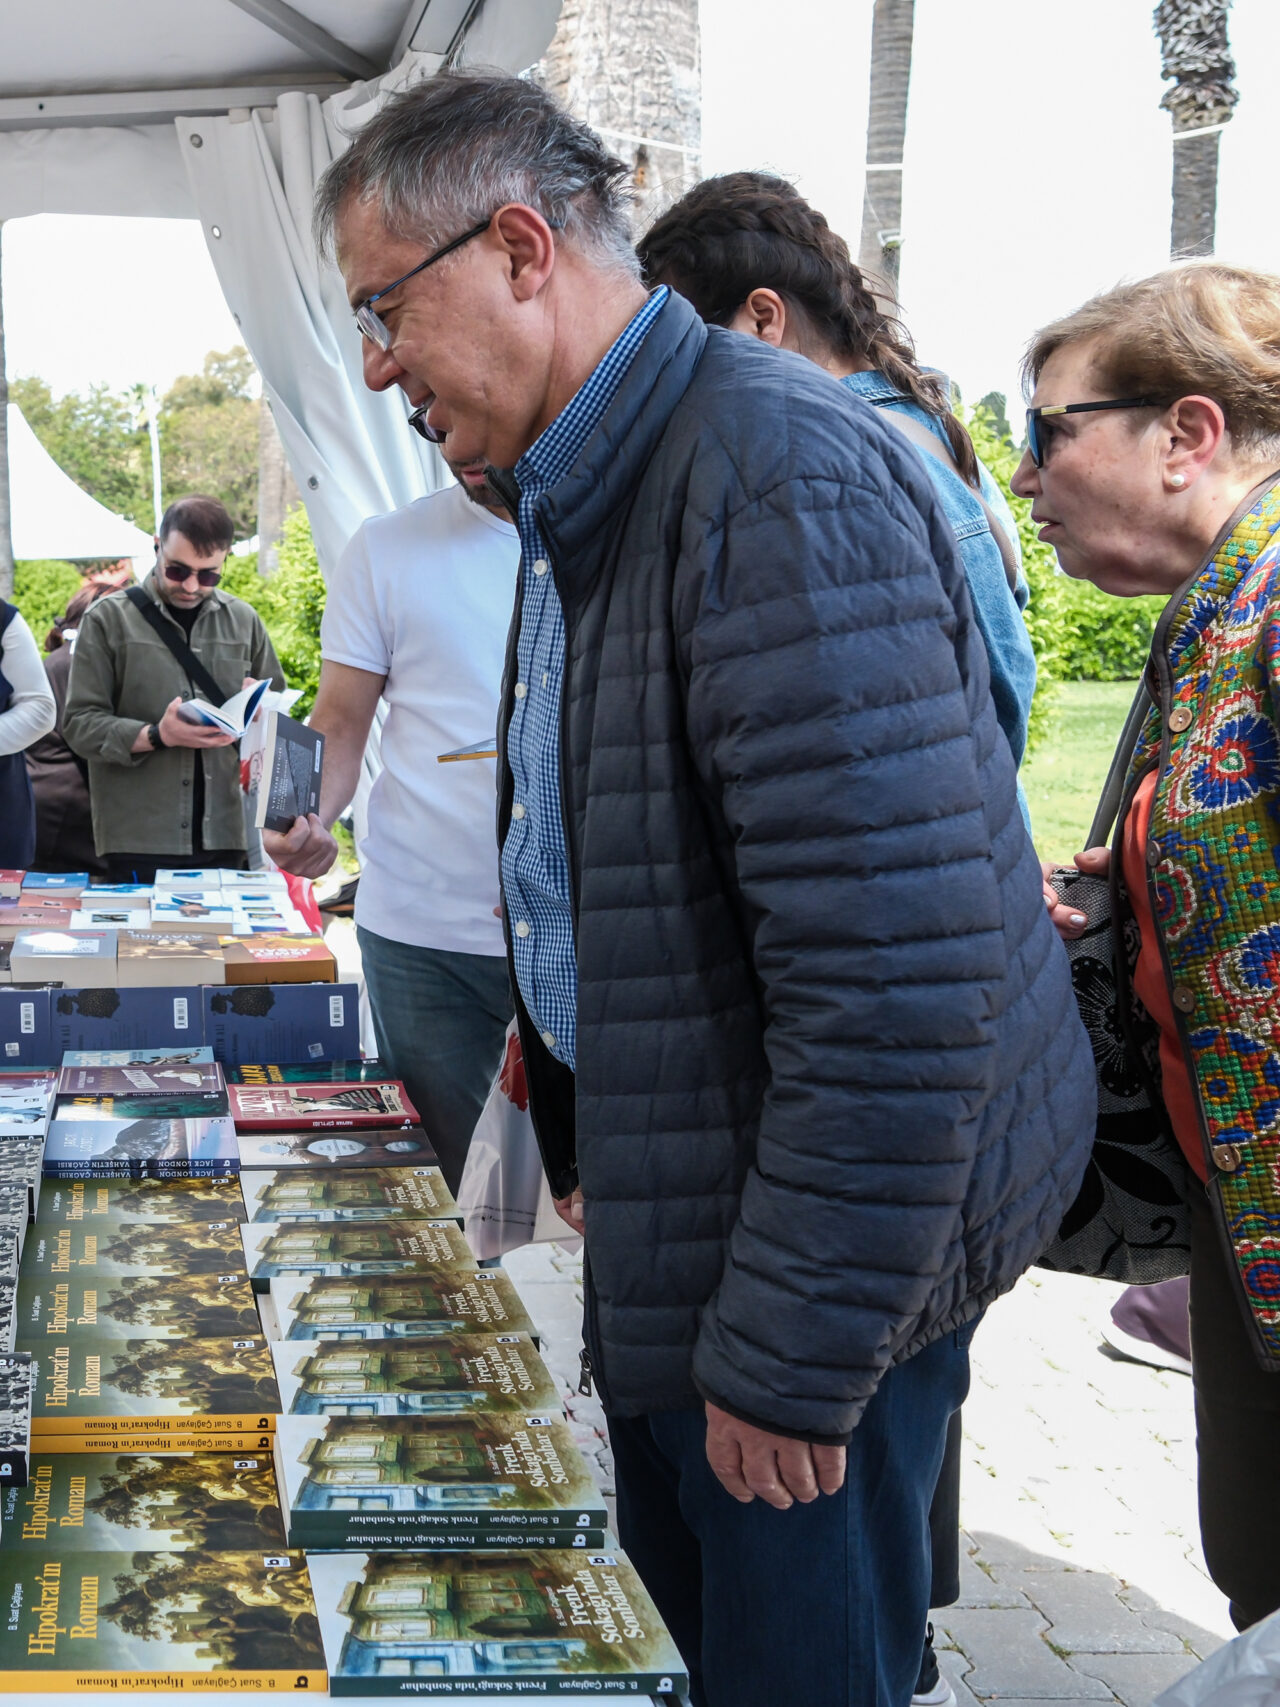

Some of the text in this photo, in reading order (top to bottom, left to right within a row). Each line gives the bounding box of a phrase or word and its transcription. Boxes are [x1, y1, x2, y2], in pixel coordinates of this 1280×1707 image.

[158, 1160, 214, 1168] JACK LONDON
[159, 1170, 215, 1178] JACK LONDON
[47, 1283, 75, 1335] Hipokrat'ın
[77, 1290, 98, 1325] Romanı
[45, 1346, 76, 1407] Hipokrat'ın
[78, 1355, 101, 1397] Romanı
[469, 1356, 494, 1384] Frenk
[505, 1347, 535, 1391] Sonbahar
[84, 1420, 171, 1430] Hipokrat'ın Romanı
[176, 1419, 243, 1429] B. Suat Çağlayan
[85, 1438, 171, 1449] Hipokrat'ın Romanı
[176, 1438, 244, 1448] B. Suat Çağlayan
[495, 1442, 524, 1475] Frenk
[535, 1433, 570, 1484] Sonbahar
[22, 1465, 57, 1540] Hipokrat'ın
[60, 1475, 86, 1528] Romanı
[348, 1515, 479, 1525] Frenk Sokağı'nda Sonbahar
[490, 1514, 560, 1525] B. Suat Çağlayan
[345, 1535, 476, 1545] Frenk Sokağı'nda Sonbahar
[486, 1535, 556, 1545] B. Suat Çağlayan
[28, 1562, 67, 1656] Hipokrat'ın
[70, 1575, 99, 1640] Romanı
[556, 1583, 593, 1627] Frenk
[600, 1572, 646, 1640] Sonbahar
[77, 1676, 185, 1688] Hipokrat'ın Romanı
[192, 1677, 276, 1688] B. Suat Çağlayan
[399, 1680, 547, 1691] Frenk Sokağı'nda Sonbahar
[559, 1679, 638, 1690] B. Suat Çağlayan
